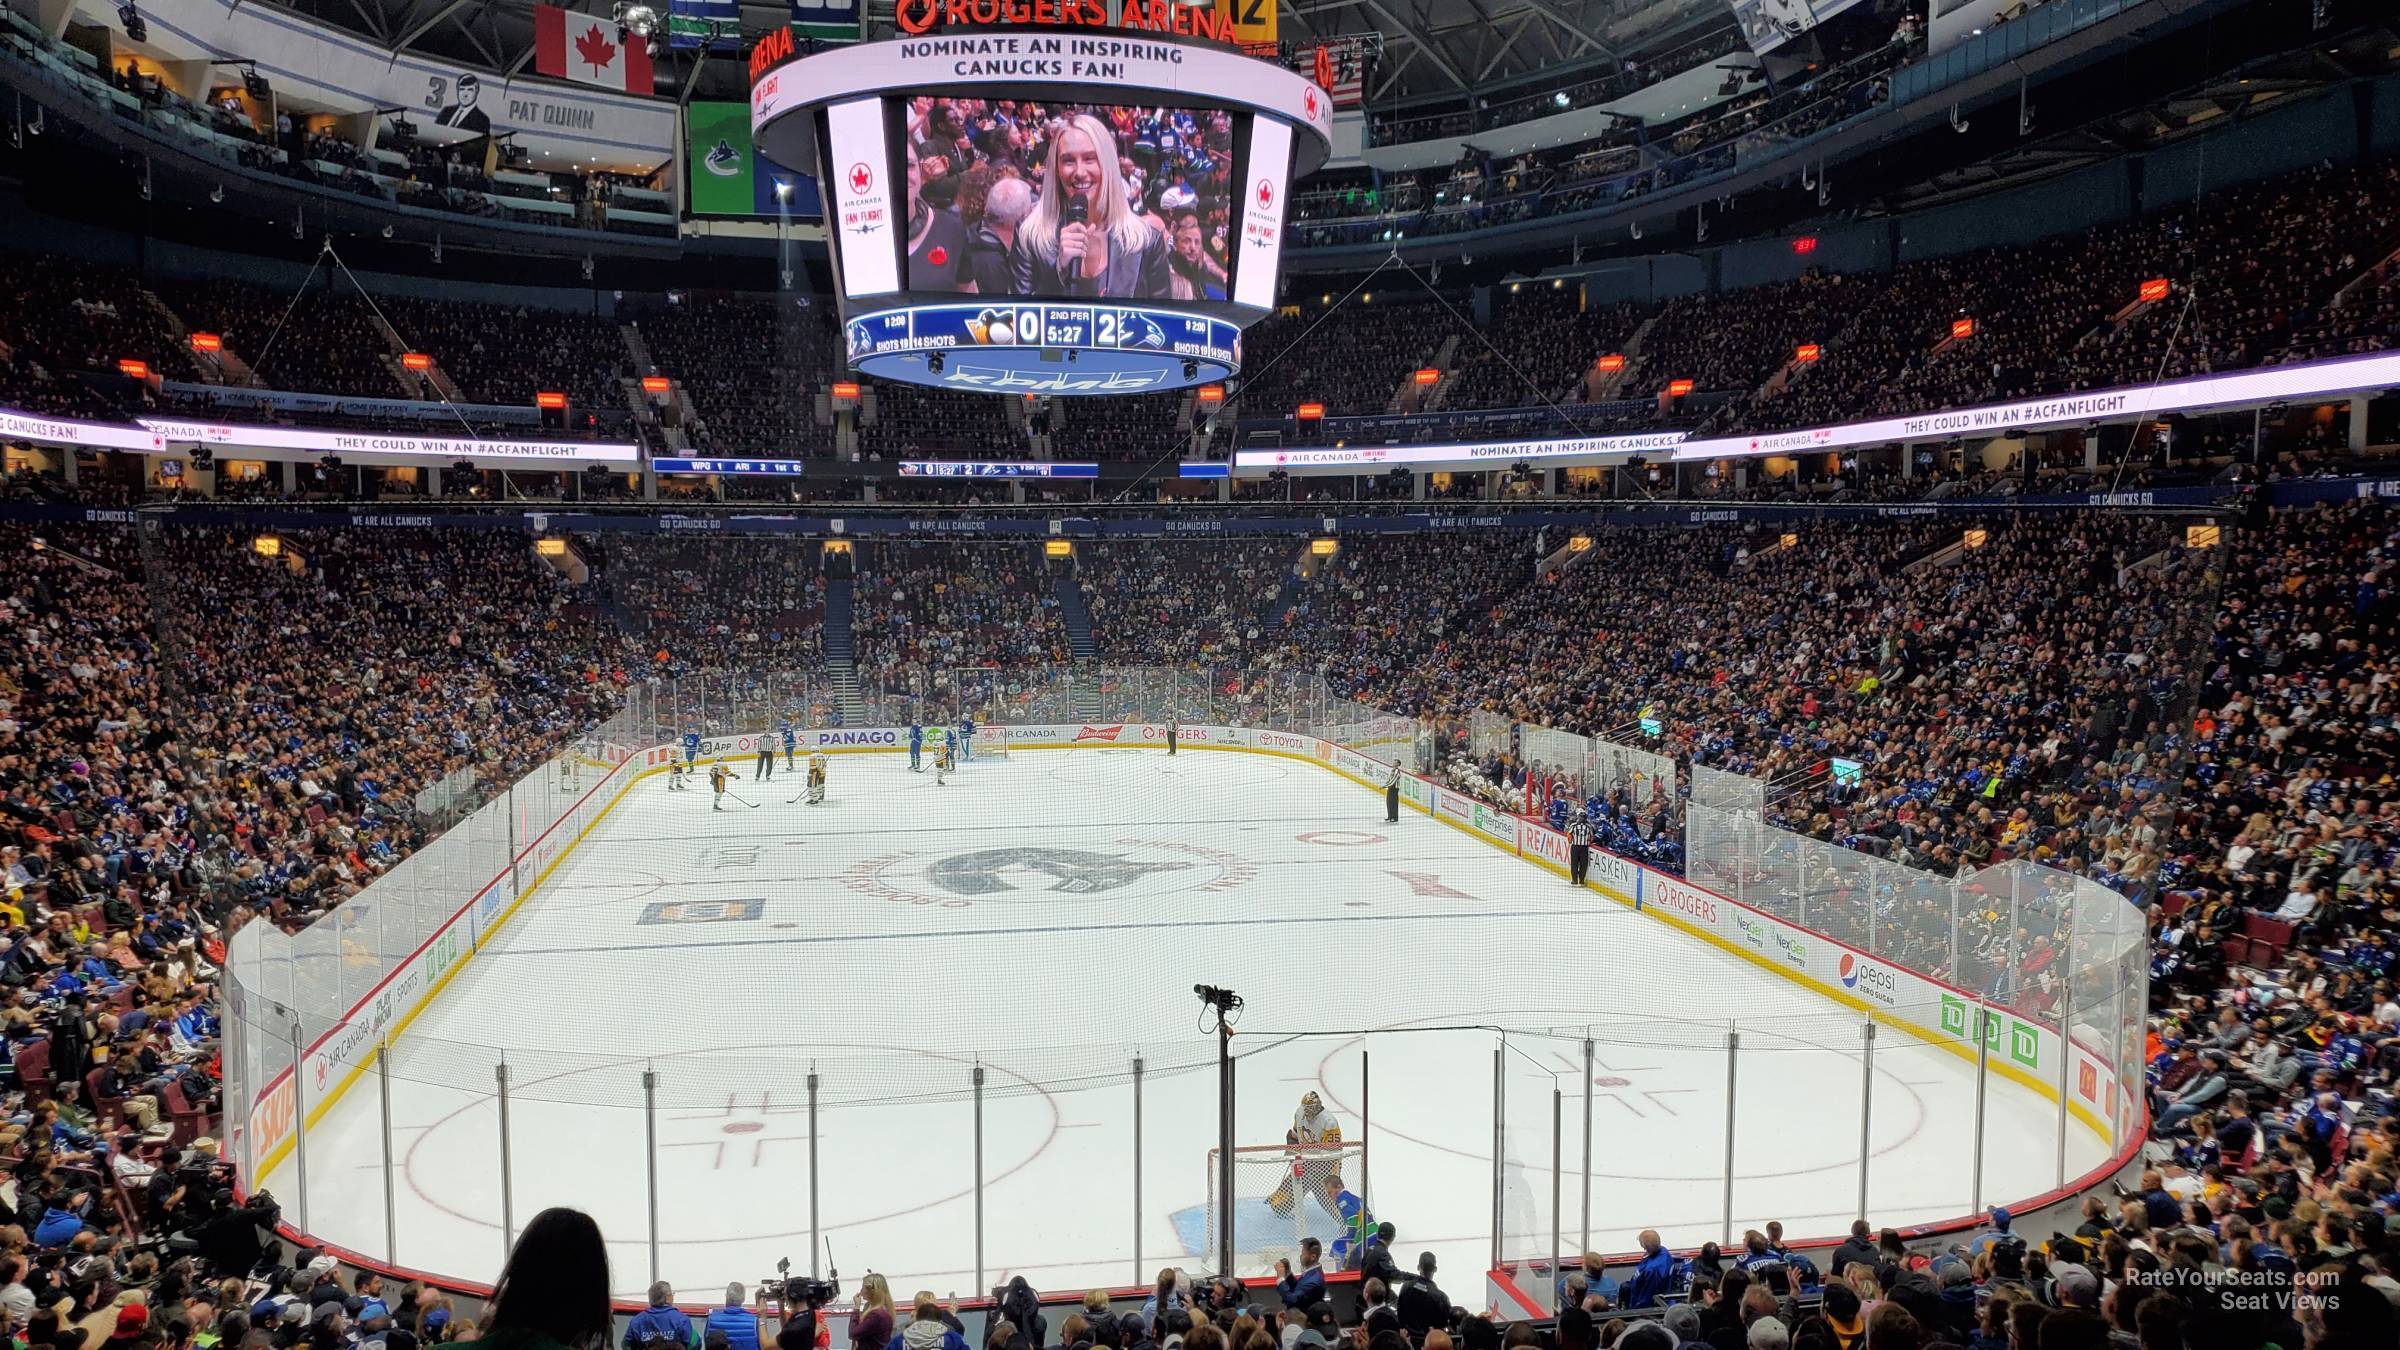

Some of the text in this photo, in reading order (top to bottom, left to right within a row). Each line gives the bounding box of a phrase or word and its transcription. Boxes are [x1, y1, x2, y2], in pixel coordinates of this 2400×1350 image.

[946, 0, 1240, 45] ROGERS ARENA
[901, 38, 1182, 64] NOMINATE AN INSPIRING
[954, 60, 1124, 79] CANUCKS FAN!
[425, 76, 448, 109] 3
[508, 100, 595, 130] PAT QUINN
[856, 197, 882, 206] CANADA
[845, 209, 883, 226] FAN FLIGHT
[1257, 213, 1276, 223] CANADA
[1049, 311, 1090, 321] 2ND PER
[1019, 310, 1039, 341] 0
[1096, 313, 1116, 343] 2
[1185, 320, 1206, 333] 9 2:00
[912, 334, 956, 348] 14 SHOTS
[1047, 326, 1083, 343] 5:27
[876, 337, 909, 353] SHOTS 19
[1174, 341, 1208, 356] SHOTS 19
[1904, 395, 2127, 434] THEY COULD WIN AN #ACFANFLIGHT
[7, 418, 47, 437] CANUCKS
[49, 424, 78, 440] FAN!
[155, 425, 203, 438] CANADA
[335, 437, 577, 457] THEY COULD WIN AN #ACFANFLIGHT
[1469, 436, 1673, 457] NOMINATE AN INSPIRING CANUCKS
[1762, 435, 1811, 449] AIR CANADA
[1291, 453, 1311, 463] AIR
[1313, 452, 1359, 463] CANADA
[692, 461, 711, 471] WPG
[735, 462, 750, 472] ARI
[760, 463, 766, 472] 2
[774, 464, 787, 473] 1st
[926, 463, 934, 475] 0
[965, 464, 975, 475] 2
[2357, 480, 2400, 498] WE ARE
[2089, 492, 2153, 506] GO CANUCKS GO
[86, 510, 96, 521] GO
[97, 510, 126, 522] CANUCKS
[352, 515, 432, 527] WE ARE ALL CANUCKS
[1429, 516, 1502, 528] WE ARE ALL CANUCKS
[1690, 510, 1738, 523] GO CANUCKS GO
[660, 519, 721, 530] GO CANUCKS GO
[909, 521, 921, 531] WE
[937, 521, 950, 531] ALL
[952, 520, 985, 531] CANUCKS
[1166, 521, 1221, 532] GO CANUCKS GO
[818, 731, 896, 746] PANAGO
[1015, 729, 1056, 738] CANADA
[1080, 727, 1121, 740] Budweiser
[1157, 728, 1207, 740] RGERS
[1273, 735, 1304, 749] TOYOTA
[1475, 808, 1513, 835] enterprise
[1526, 826, 1571, 865] RE/MAX
[1588, 850, 1628, 883] FASKEN
[1670, 887, 1717, 924] ROGERS
[1737, 914, 1764, 938] NexGen
[1776, 932, 1806, 957] NexGen
[1787, 952, 1806, 968] Energy
[1860, 963, 1896, 992] pepsi
[397, 971, 418, 1003] SPORTS
[1859, 984, 1895, 1007] ZERO SUGAR
[1942, 1003, 1964, 1028] TD
[328, 1017, 370, 1070] AIR CANADA
[2014, 1029, 2036, 1059] TD
[260, 1077, 295, 1157] SKIP
[1328, 1133, 1341, 1143] 35
